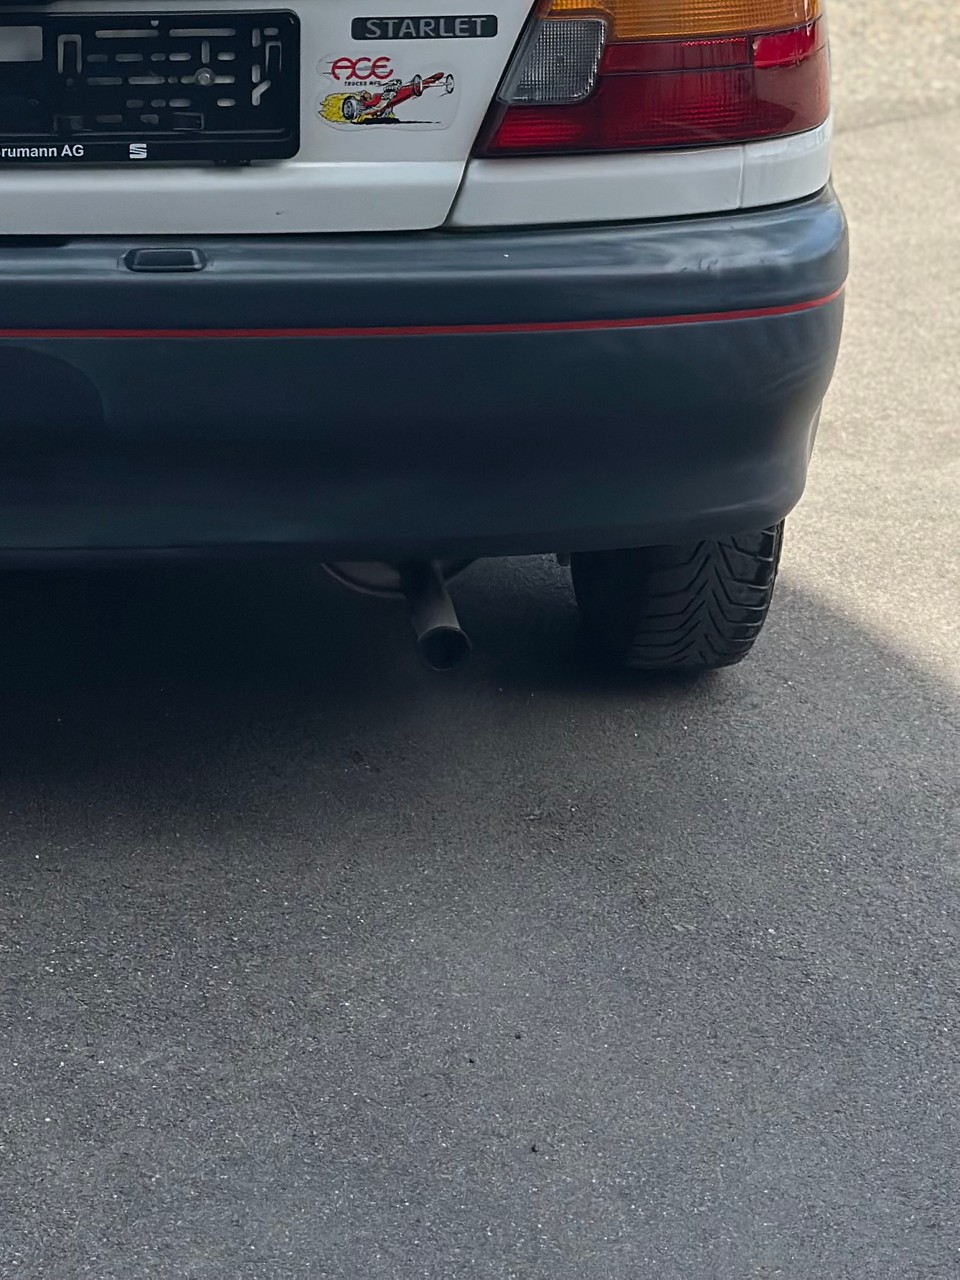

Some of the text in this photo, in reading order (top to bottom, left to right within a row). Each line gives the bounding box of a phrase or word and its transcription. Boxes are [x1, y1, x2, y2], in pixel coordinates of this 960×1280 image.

[365, 18, 487, 38] STARLET
[331, 56, 394, 80] ACE
[61, 144, 84, 157] AG
